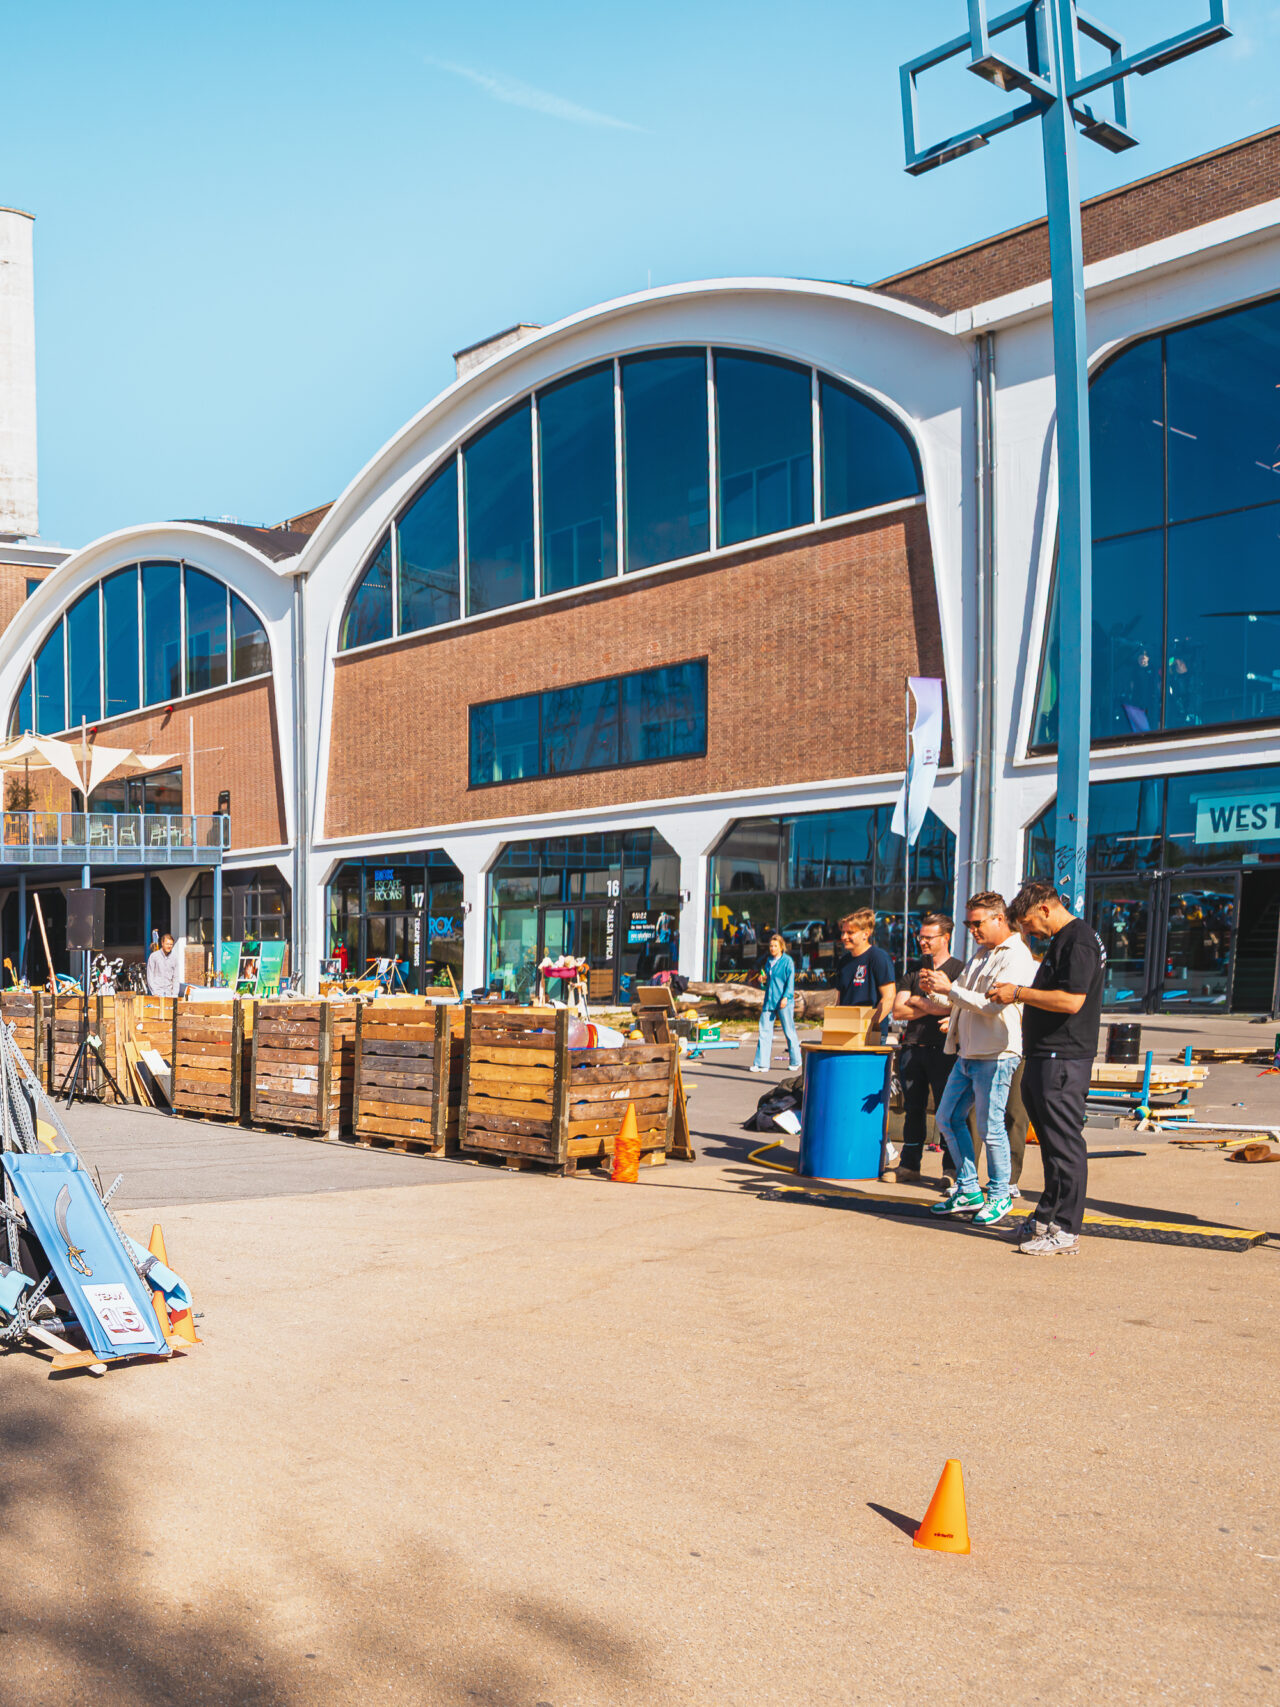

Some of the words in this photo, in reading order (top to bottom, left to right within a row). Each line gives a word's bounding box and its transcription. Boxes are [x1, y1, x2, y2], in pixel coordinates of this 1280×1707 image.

[1209, 802, 1280, 834] WEST
[374, 880, 402, 890] ESCAPE
[606, 879, 620, 898] 16
[374, 889, 402, 902] ROOMS
[414, 892, 424, 908] 17
[606, 908, 615, 934] SALSA
[605, 934, 614, 960] TIPICA
